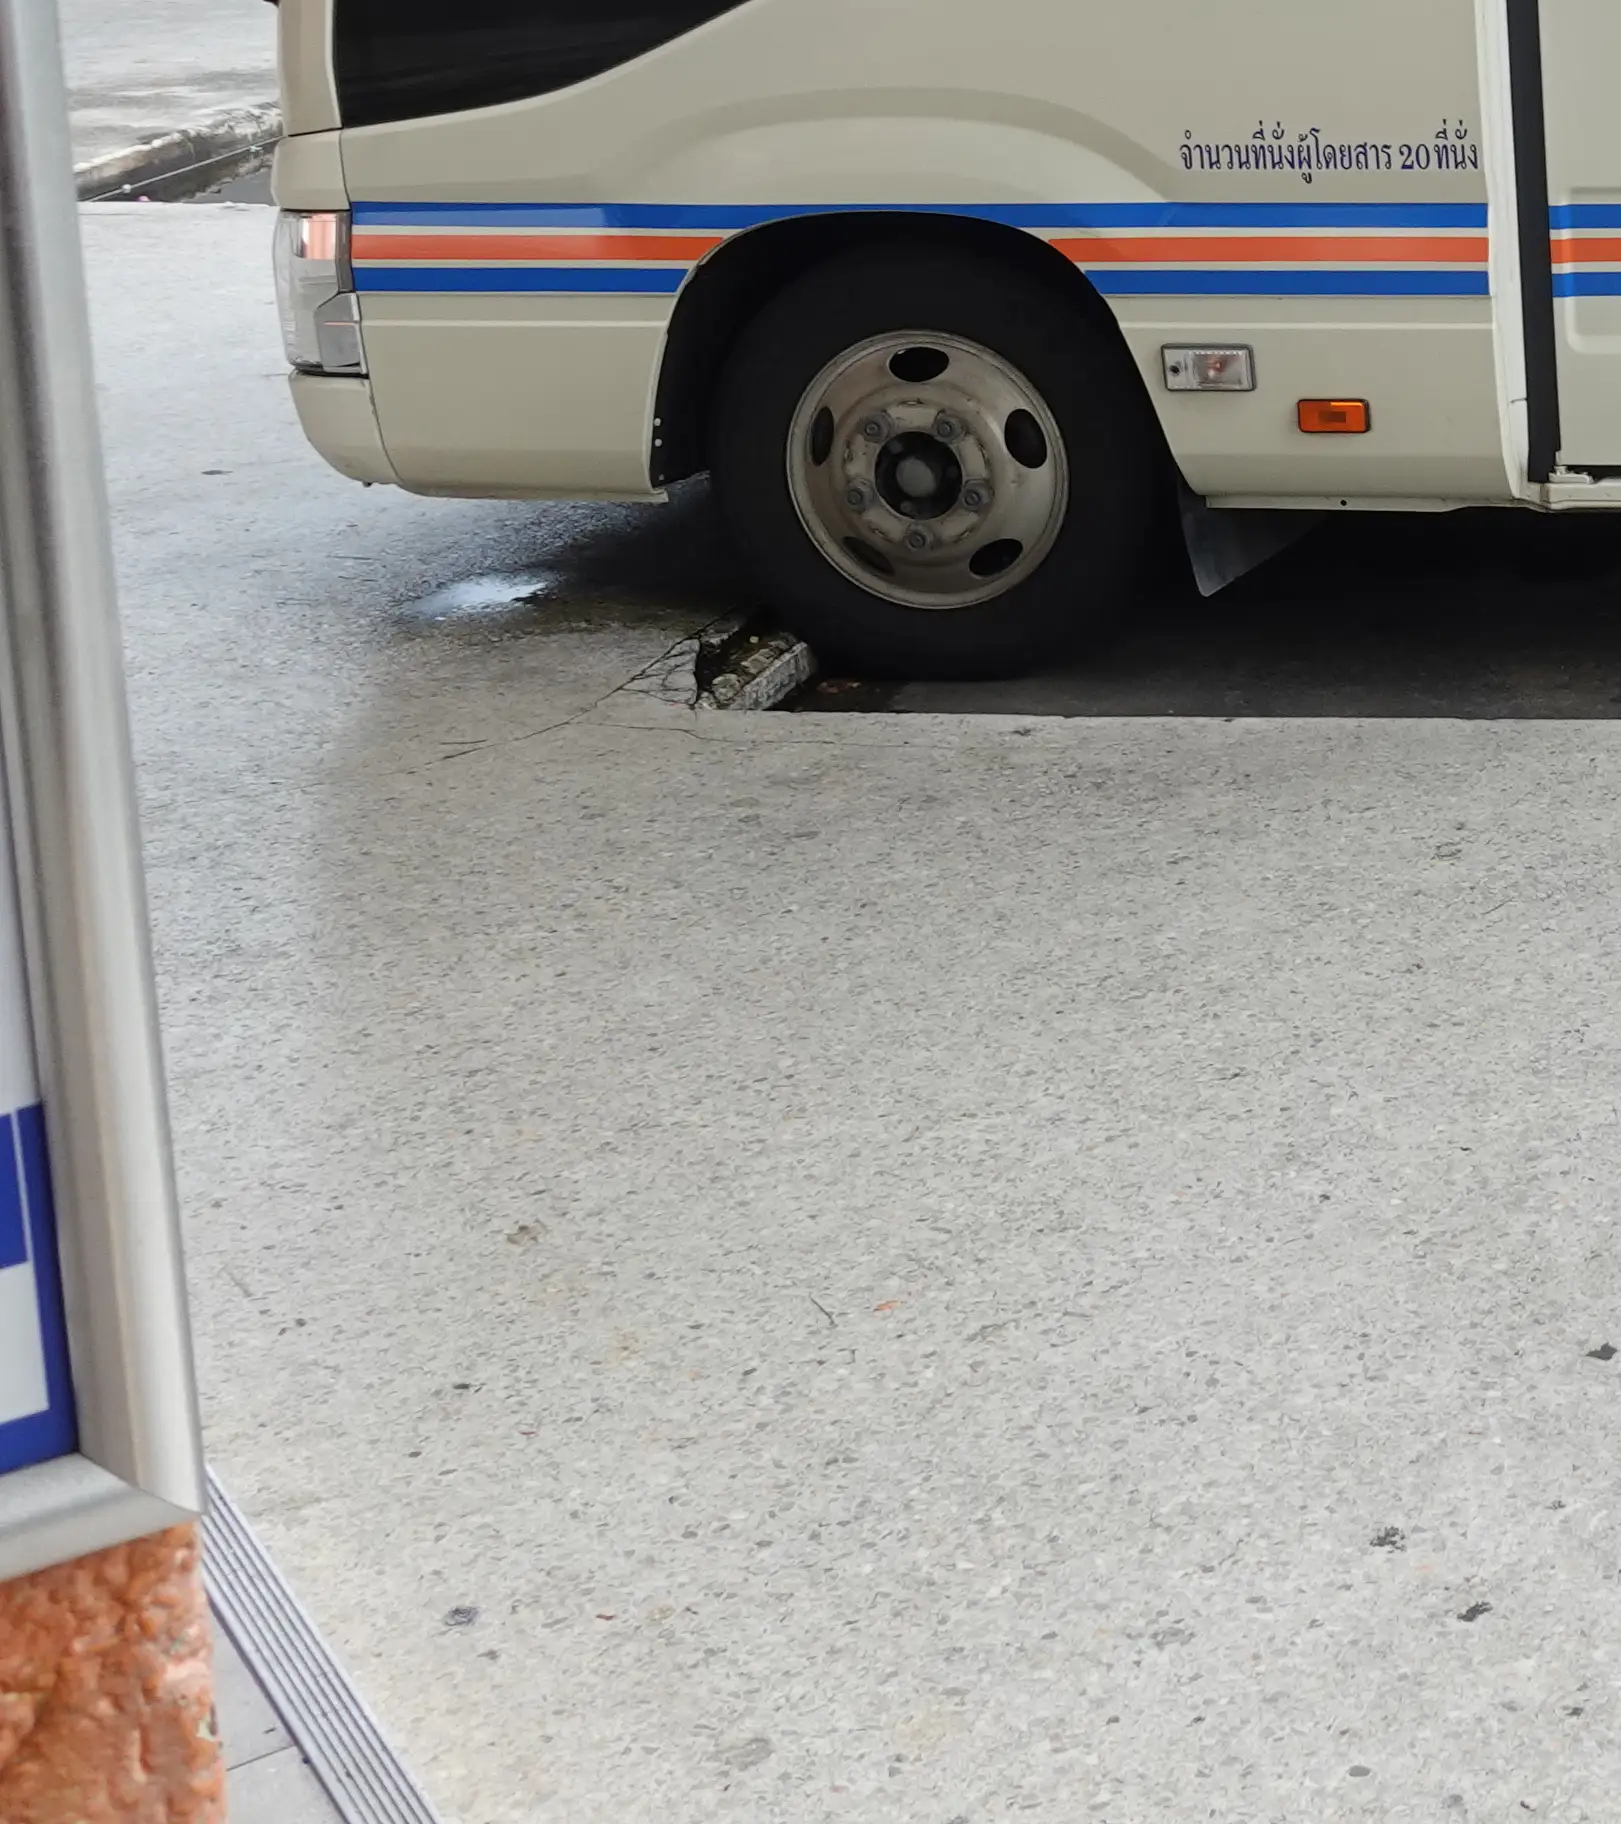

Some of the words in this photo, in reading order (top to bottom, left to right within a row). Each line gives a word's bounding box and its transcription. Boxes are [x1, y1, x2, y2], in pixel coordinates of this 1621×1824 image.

[1179, 119, 1392, 185] จำนวนที่นั่งผู้โดยสาร
[1398, 143, 1431, 170] 20
[1433, 118, 1479, 170] ที่นั่ง
